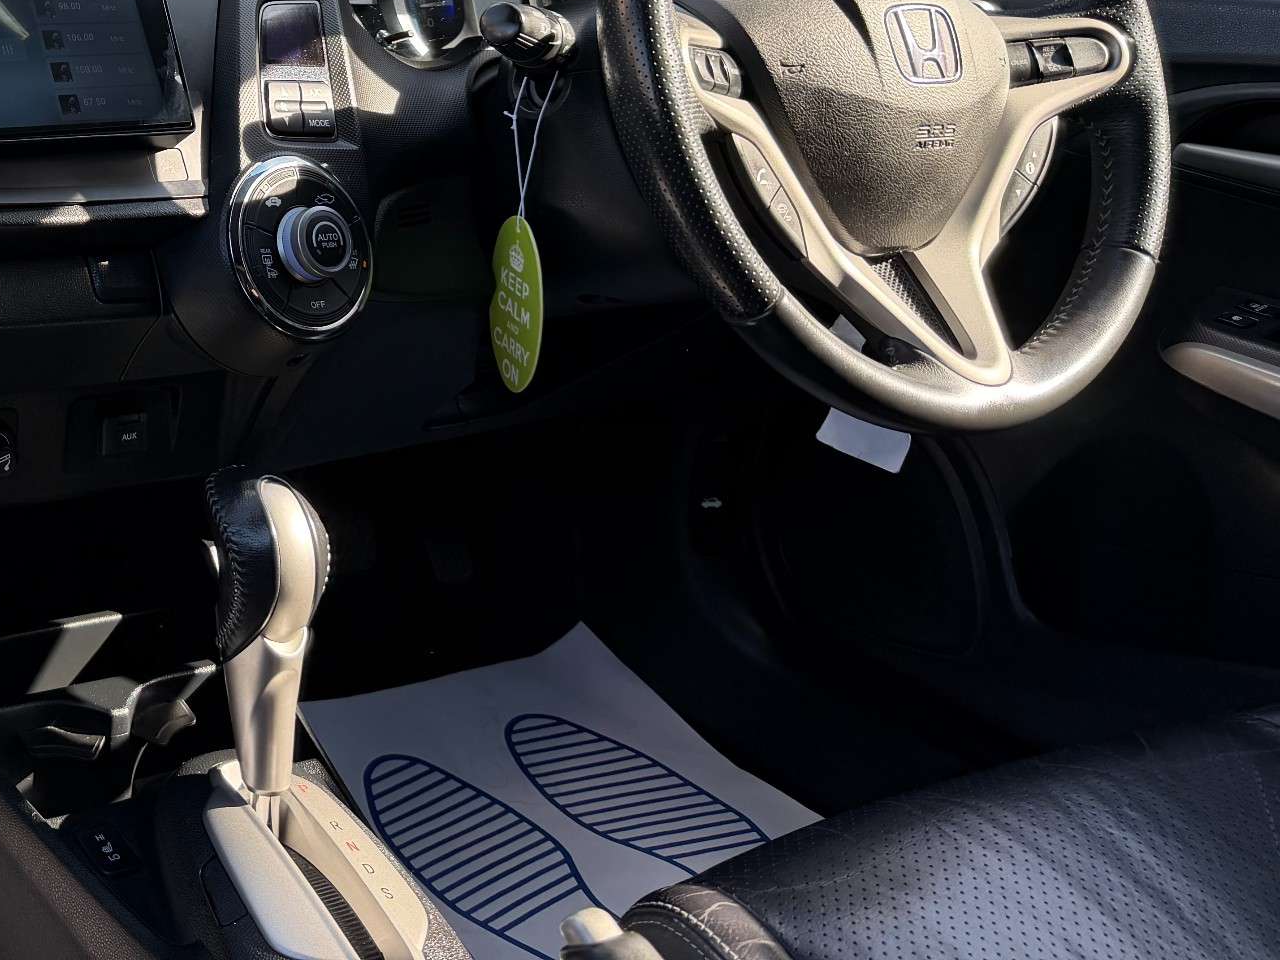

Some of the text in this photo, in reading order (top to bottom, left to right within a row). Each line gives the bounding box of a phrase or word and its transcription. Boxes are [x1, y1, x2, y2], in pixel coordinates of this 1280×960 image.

[308, 119, 331, 127] MODE
[317, 233, 338, 242] AUTO
[500, 266, 530, 300] KEEP
[310, 300, 326, 309] OFF
[497, 291, 530, 329] CALM
[494, 327, 530, 367] CARRY
[501, 358, 519, 385] ON
[121, 431, 138, 441] AUX
[330, 820, 343, 833] R
[346, 841, 361, 853] N
[362, 863, 375, 875] D
[380, 887, 394, 900] S
